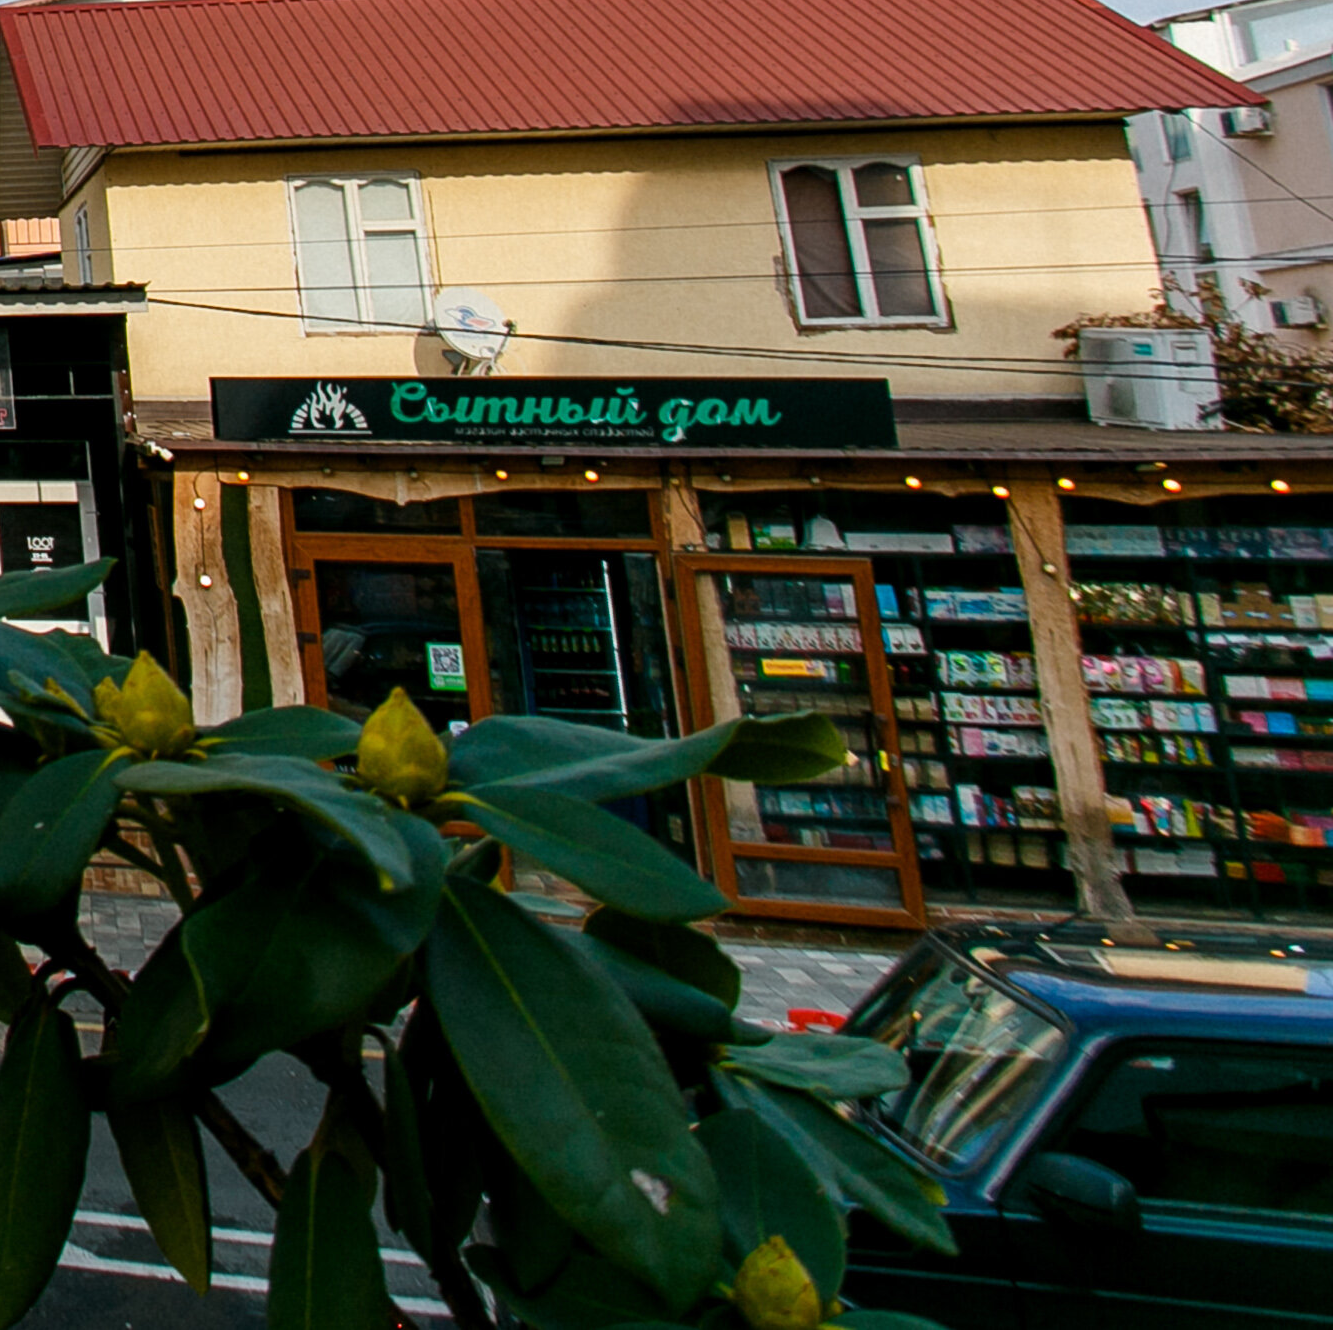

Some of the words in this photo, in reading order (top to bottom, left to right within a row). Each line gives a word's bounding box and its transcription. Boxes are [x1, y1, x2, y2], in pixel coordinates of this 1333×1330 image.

[390, 378, 647, 425] Сытный
[658, 394, 782, 443] дом
[27, 536, 55, 551] LOOT
